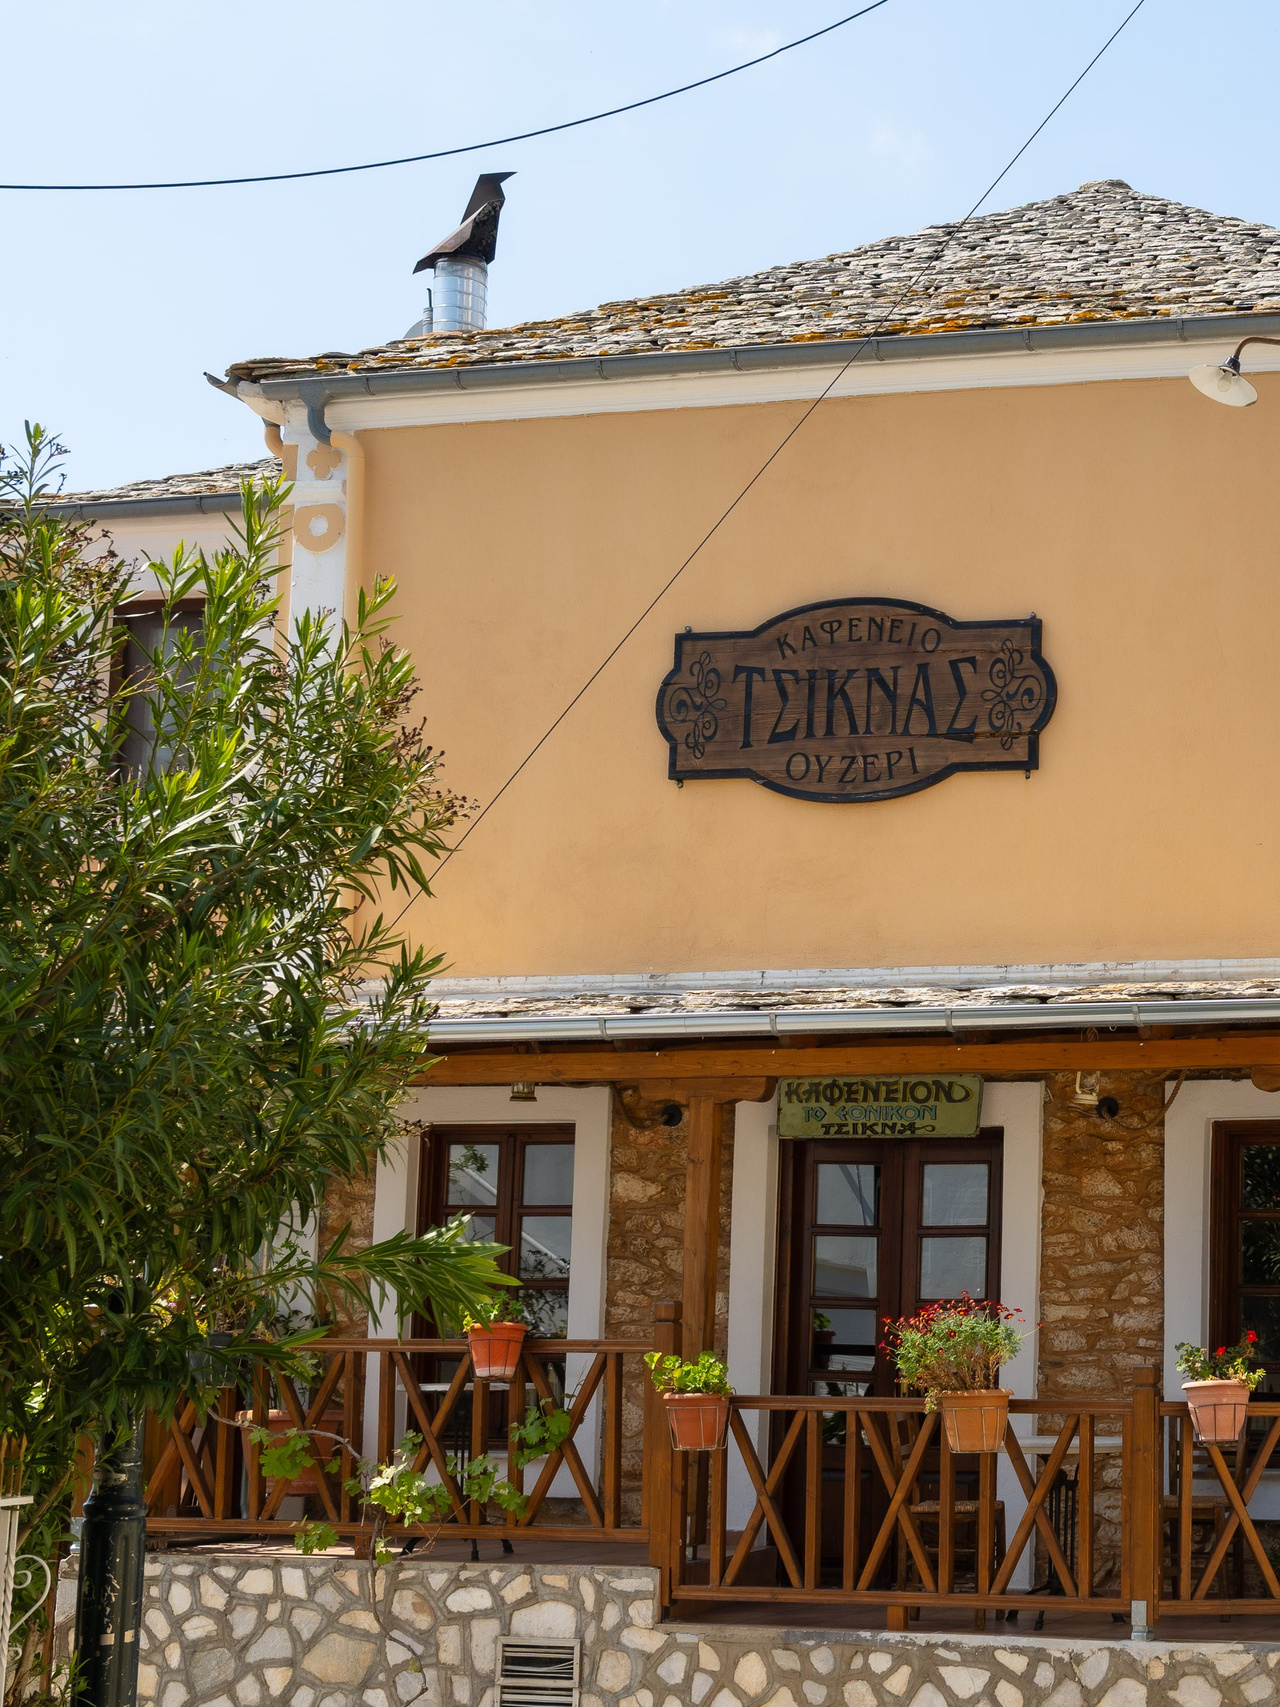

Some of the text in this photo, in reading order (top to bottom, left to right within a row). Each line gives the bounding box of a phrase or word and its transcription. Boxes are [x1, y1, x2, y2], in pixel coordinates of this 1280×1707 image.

[776, 616, 942, 660] ΚΑΦΕΝΕΙΟ
[732, 655, 979, 750] ΤΣΙΚΝΑΣ
[785, 746, 920, 784] ΟΥΖΕΡΙ
[785, 1078, 974, 1106] ΚΑΦΕΝΕΙΟΝ
[802, 1105, 827, 1122] ΤΟ
[821, 1122, 936, 1135] ΤΣΙΚΝΑ
